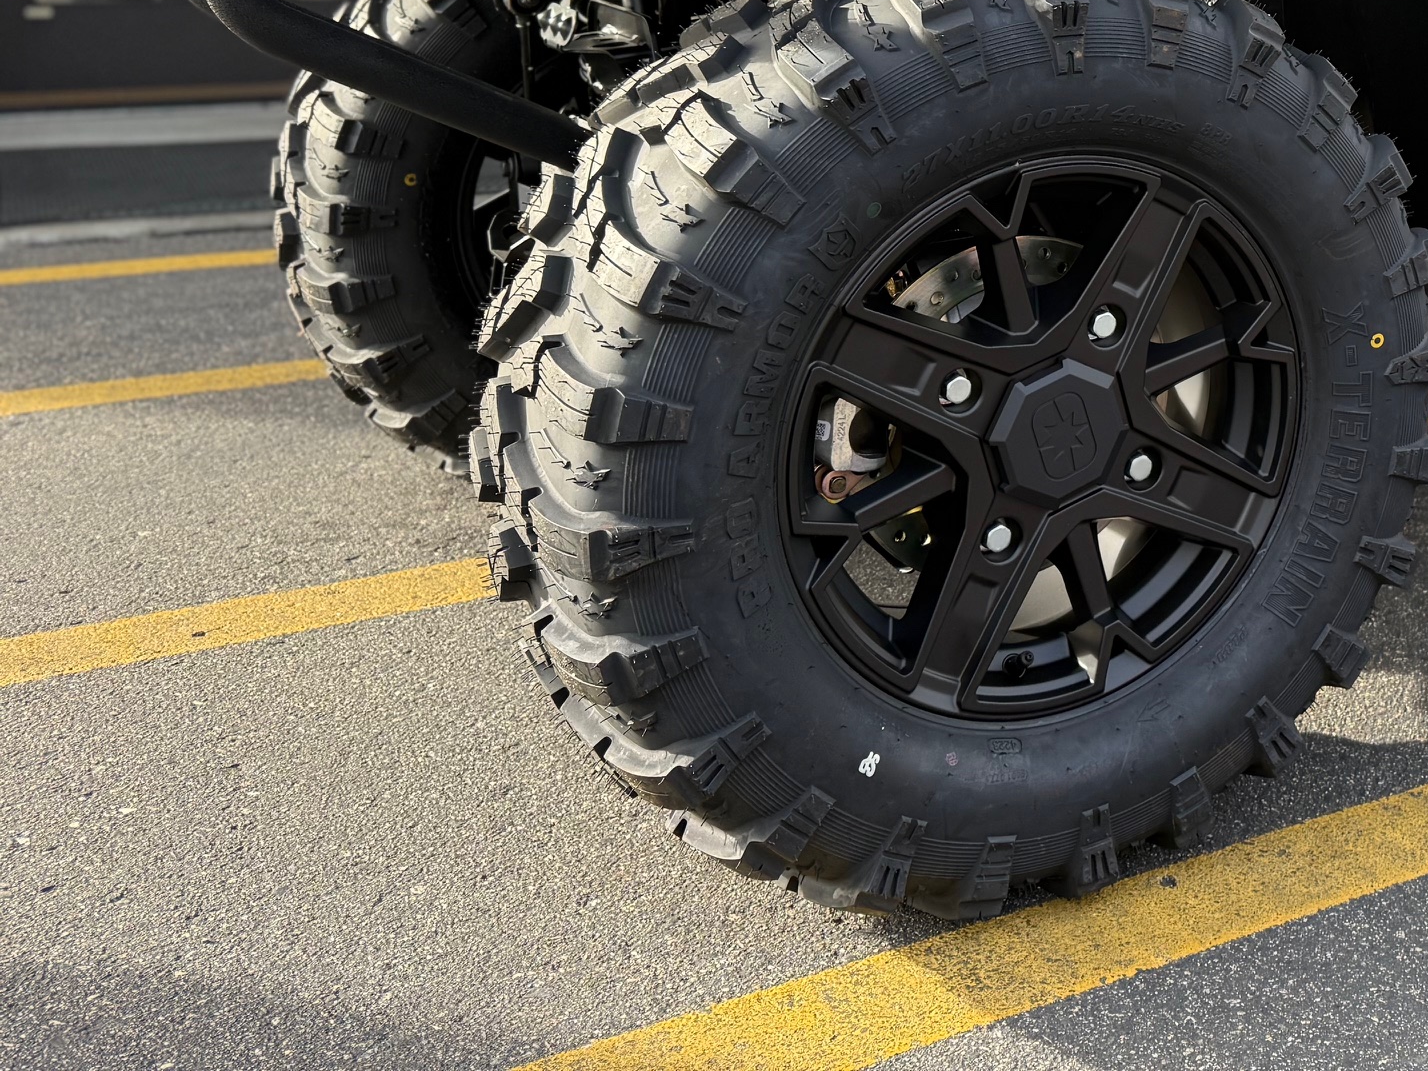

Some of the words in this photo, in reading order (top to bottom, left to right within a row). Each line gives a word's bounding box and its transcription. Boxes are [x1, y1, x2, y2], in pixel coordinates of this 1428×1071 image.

[726, 272, 826, 479] ARMOR
[1261, 300, 1374, 629] X-TERRAIN
[726, 495, 772, 620] PRO
